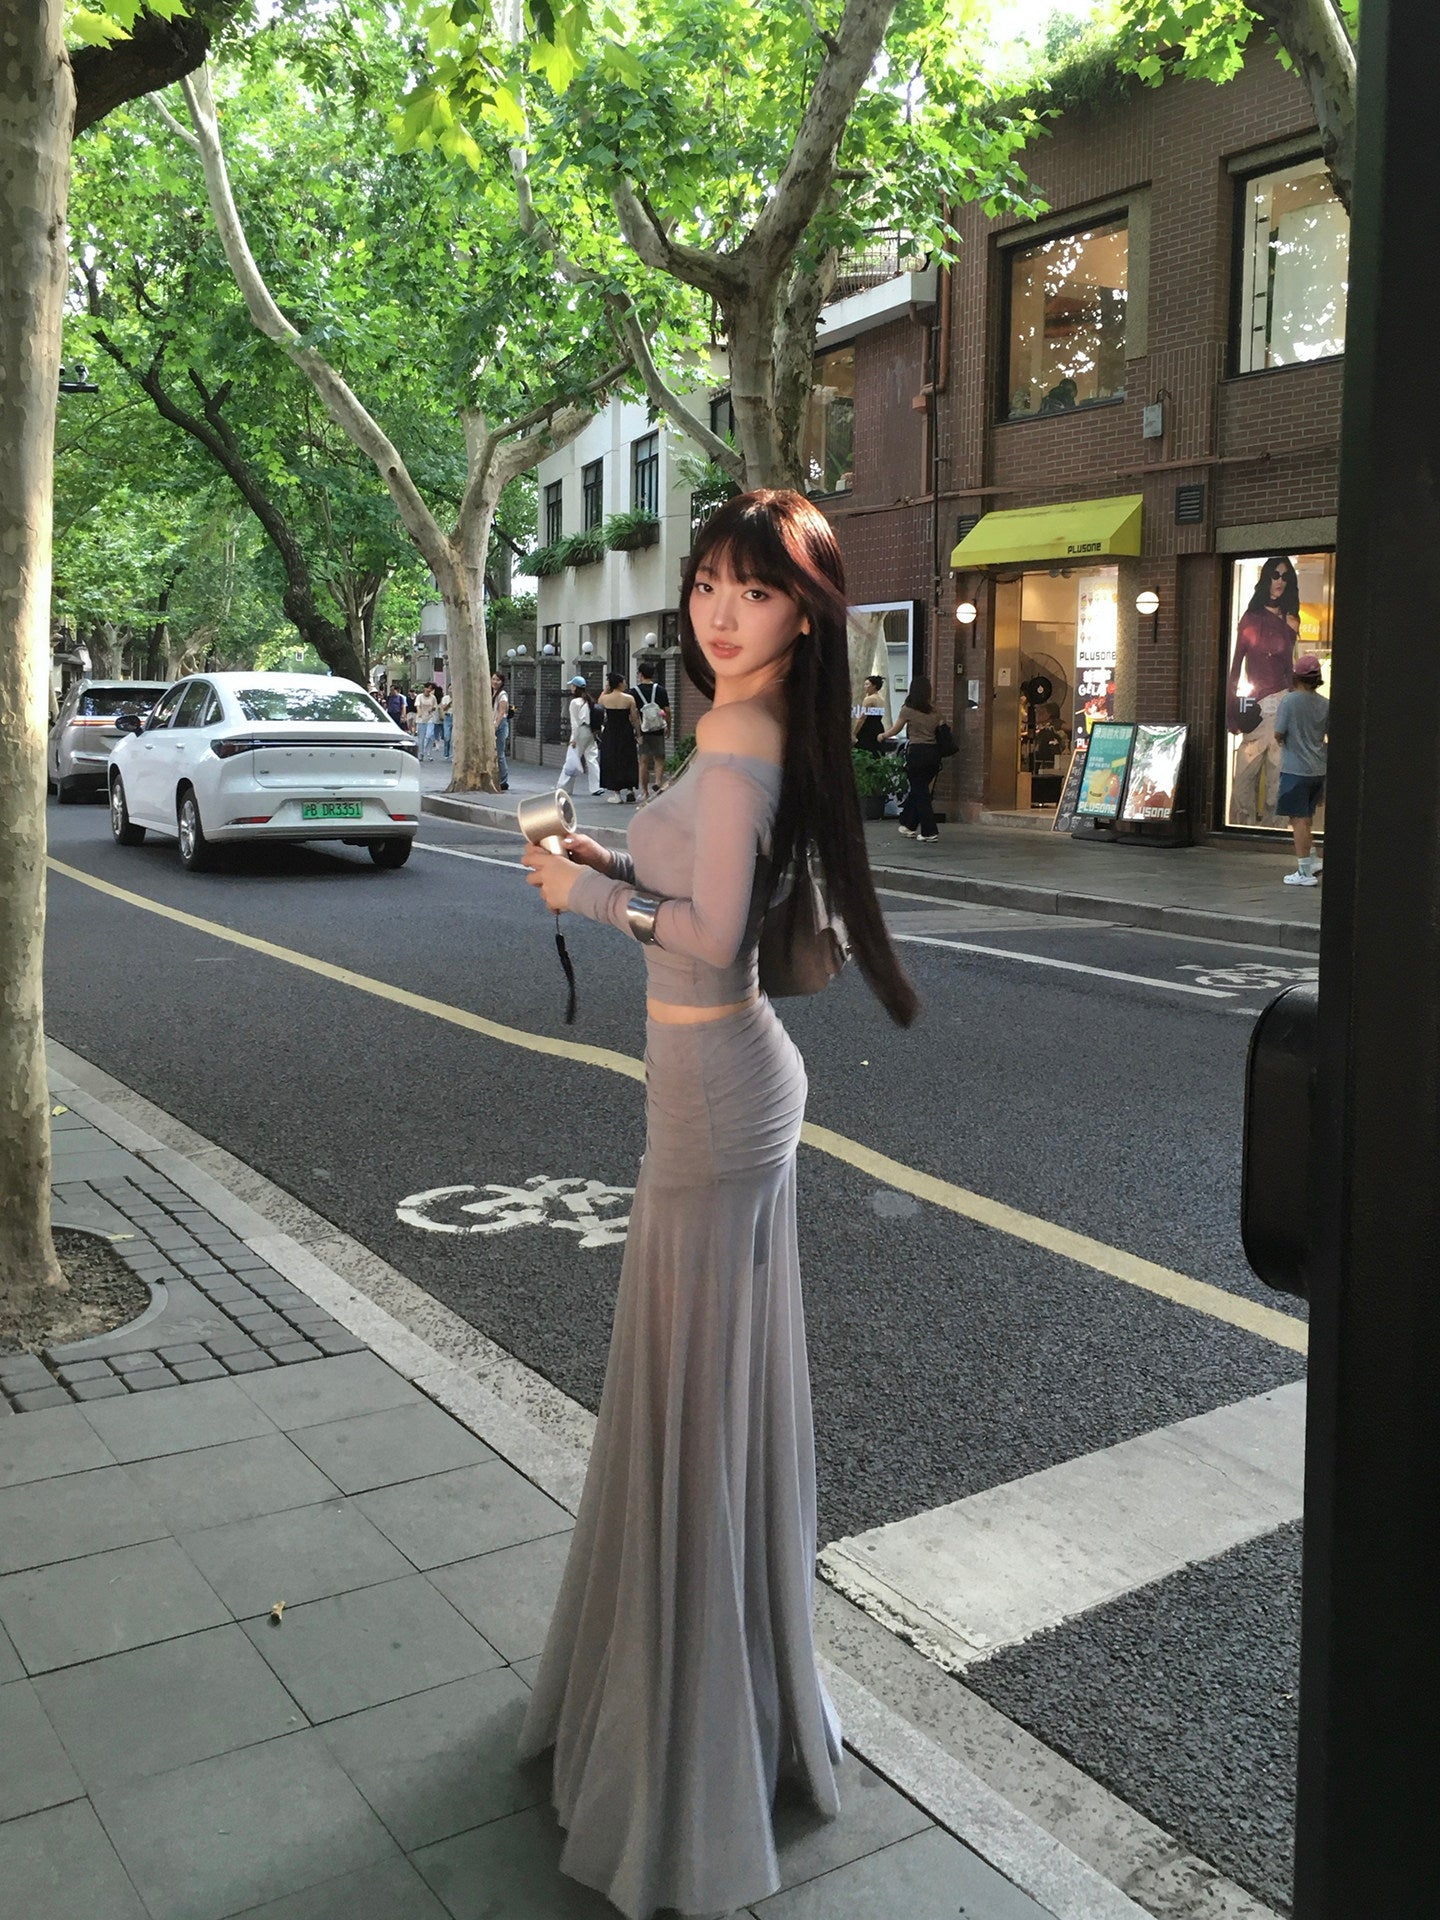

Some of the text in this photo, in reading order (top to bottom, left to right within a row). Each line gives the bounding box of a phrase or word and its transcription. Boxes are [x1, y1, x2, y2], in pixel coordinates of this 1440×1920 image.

[1068, 542, 1102, 554] PLUSONE
[1079, 651, 1116, 660] PLUSONE
[322, 802, 361, 816] DR3351
